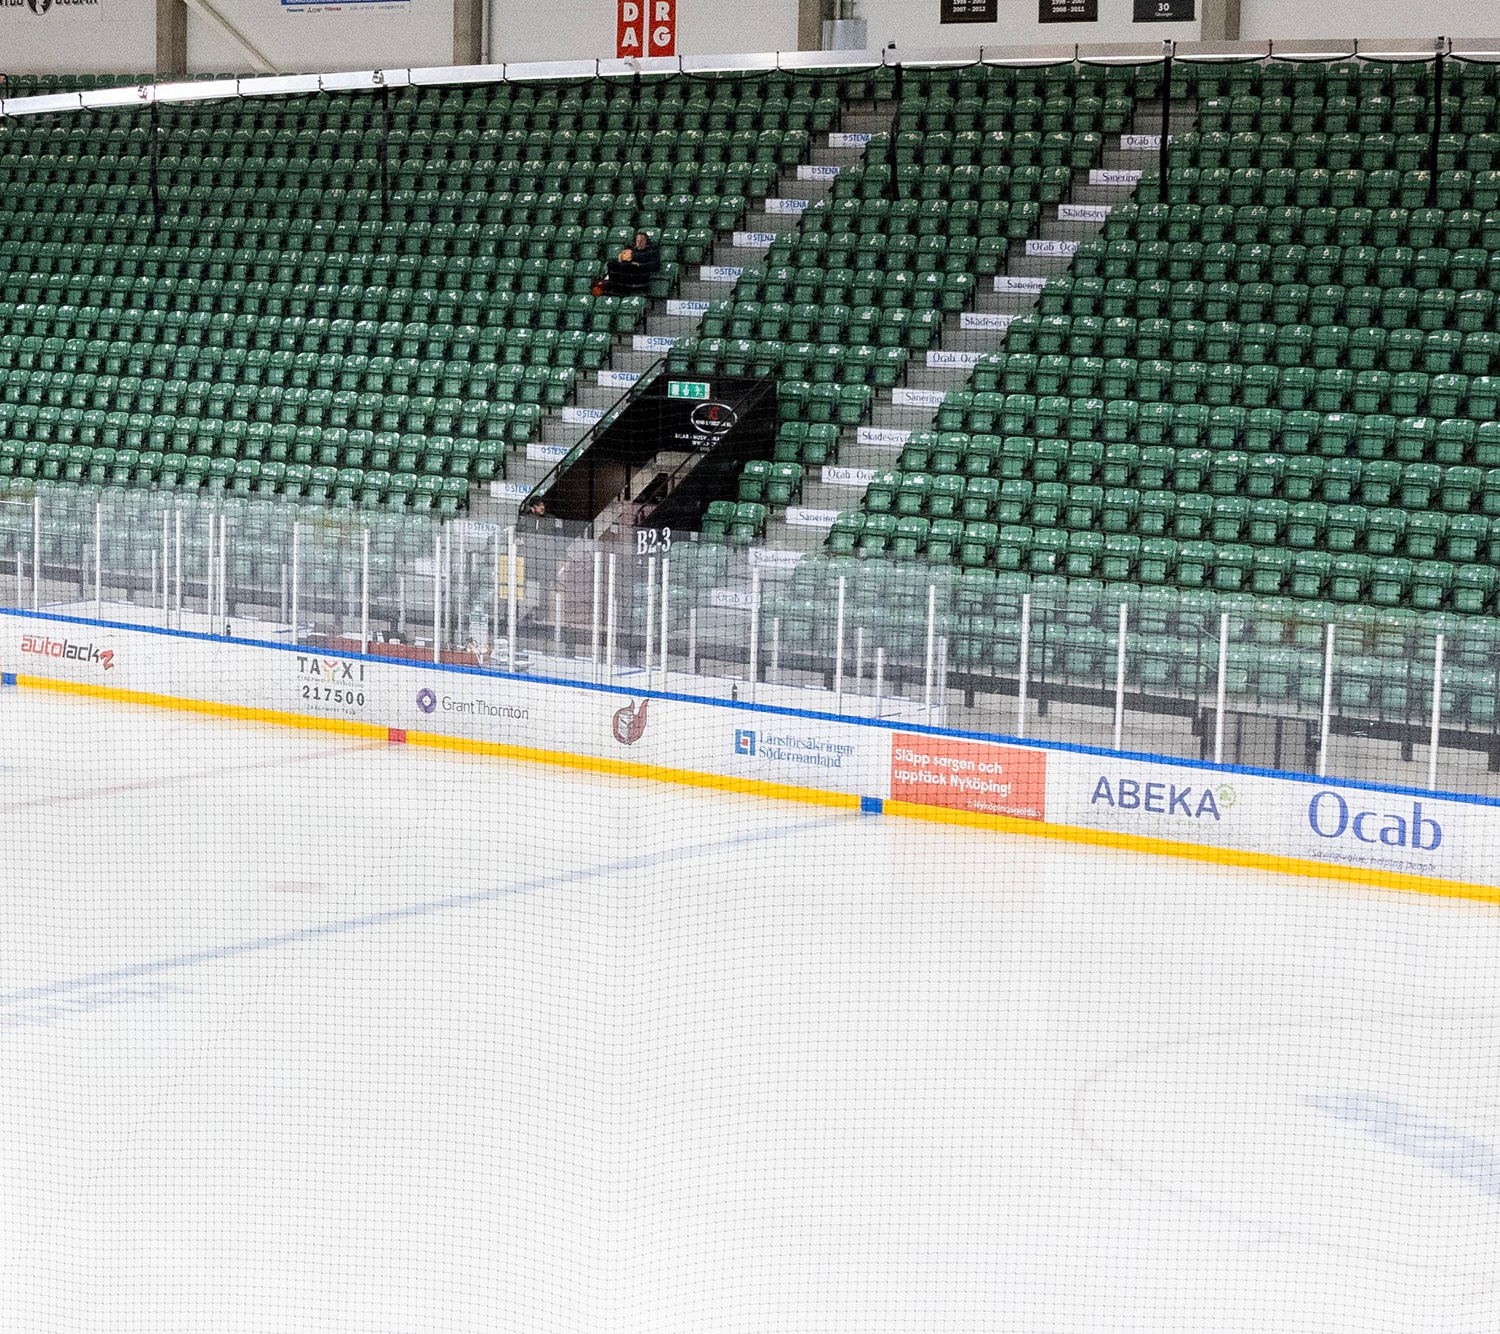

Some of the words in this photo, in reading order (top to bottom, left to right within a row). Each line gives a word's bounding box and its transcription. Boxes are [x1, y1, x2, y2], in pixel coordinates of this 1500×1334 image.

[636, 525, 672, 555] B2-3
[302, 684, 366, 707] 217500
[441, 694, 475, 716] Grant
[475, 699, 530, 720] Thornton
[894, 747, 931, 769] Släpp
[932, 755, 975, 773] sargen
[977, 759, 1003, 775] och
[894, 765, 947, 787] upptäck
[950, 773, 1013, 797] Nyköping!
[1090, 774, 1222, 822] ABEKA
[1306, 788, 1445, 853] Ocab
